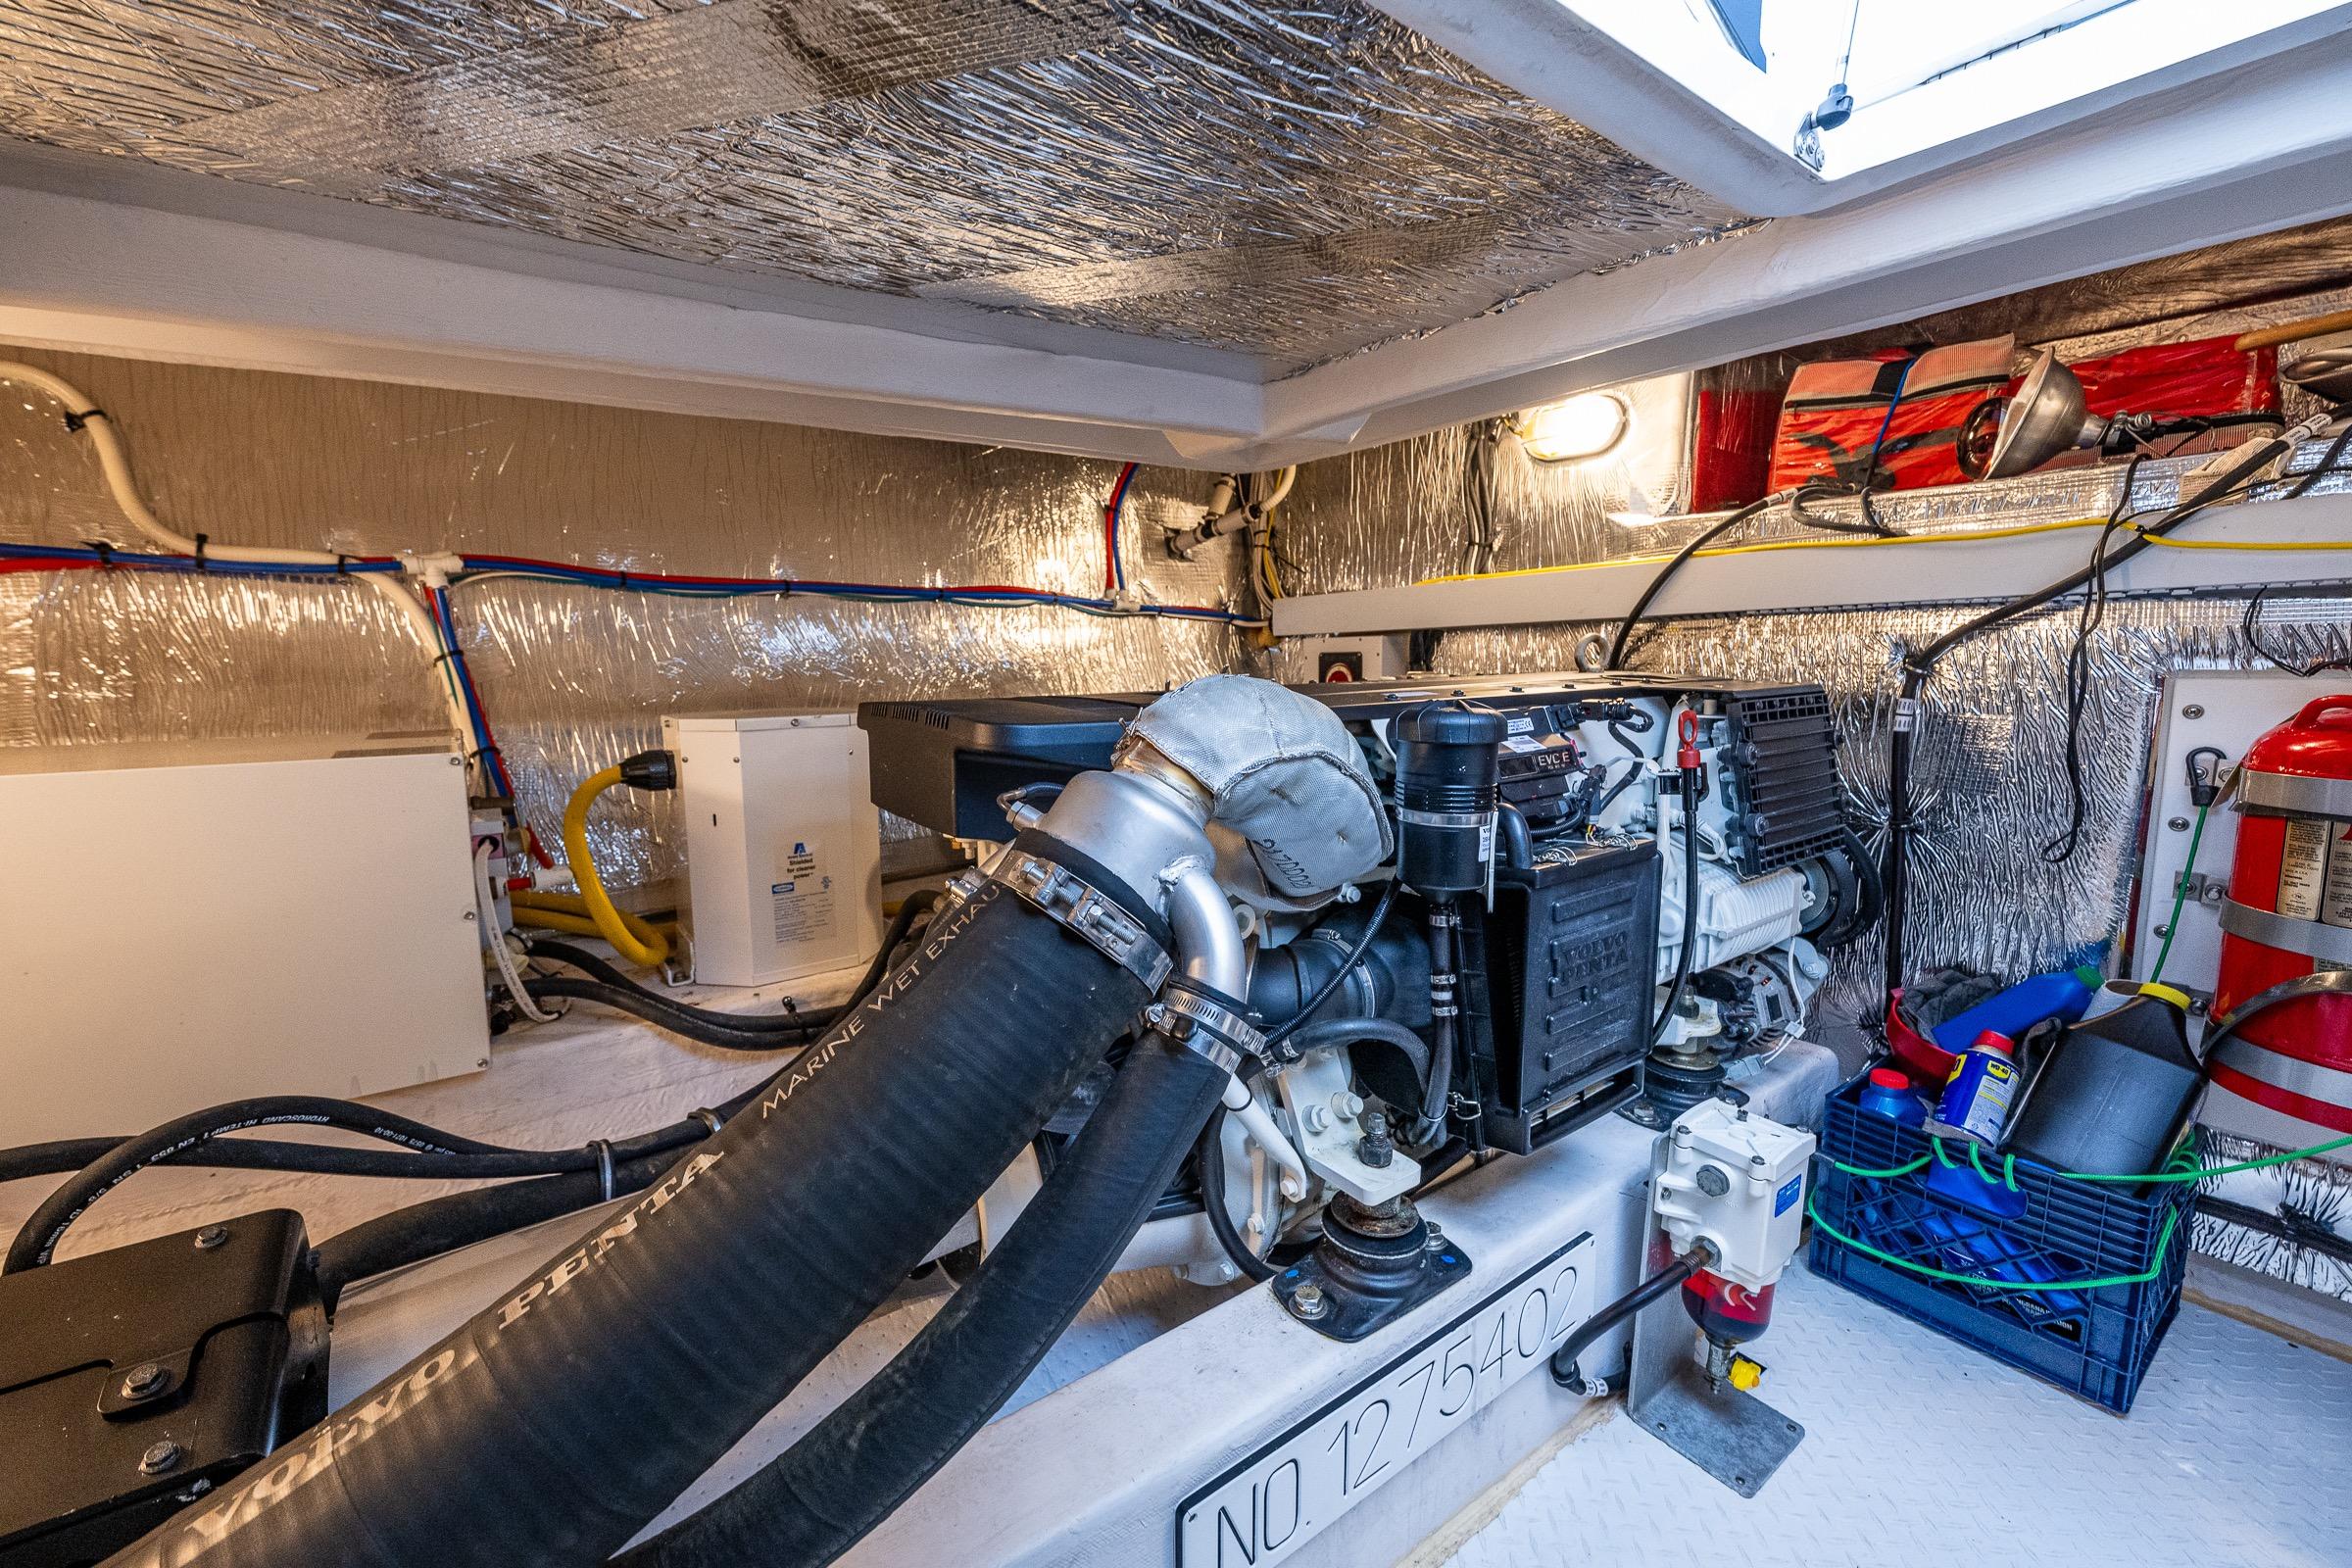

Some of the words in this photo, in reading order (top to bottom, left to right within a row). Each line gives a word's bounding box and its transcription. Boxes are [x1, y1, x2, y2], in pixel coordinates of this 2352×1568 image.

[1538, 753, 1560, 765] EVC
[1562, 752, 1570, 762] E
[762, 1014, 864, 1119] MARINE
[868, 958, 920, 1011] WET
[1990, 1061, 2009, 1076] WD-40
[183, 1348, 456, 1538] VOLVO
[498, 1151, 725, 1330] PENTA
[1217, 1457, 1311, 1568] NO.
[1326, 1265, 1578, 1496] 1275402
